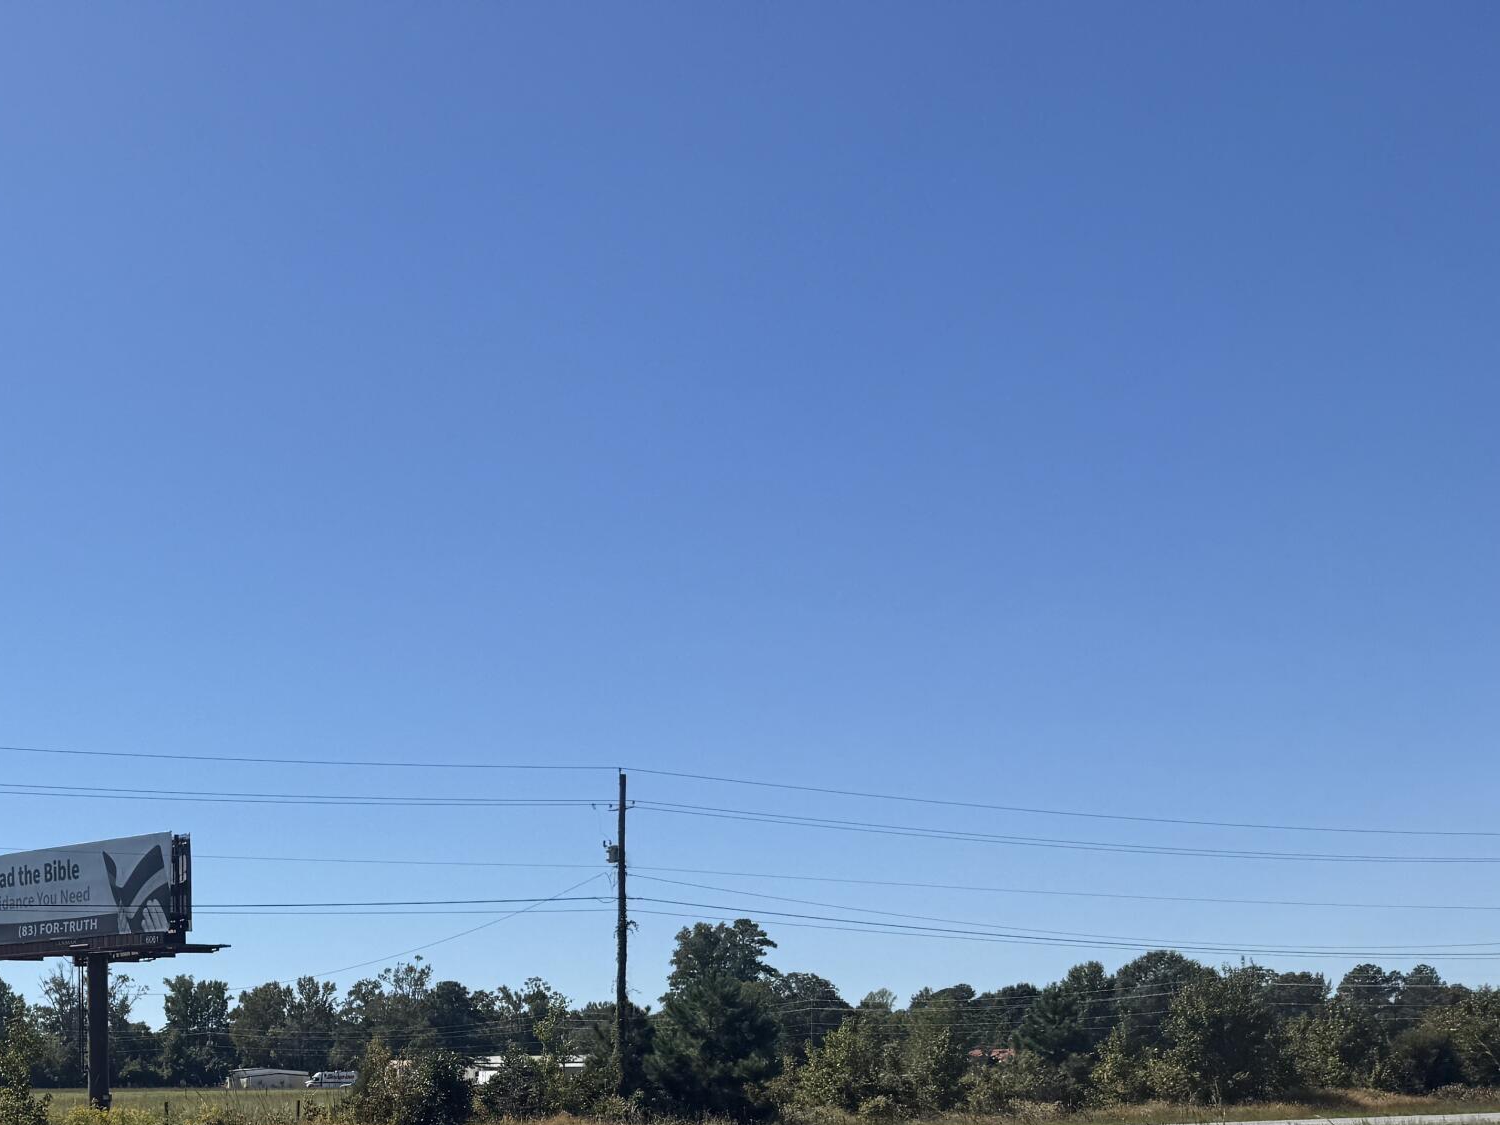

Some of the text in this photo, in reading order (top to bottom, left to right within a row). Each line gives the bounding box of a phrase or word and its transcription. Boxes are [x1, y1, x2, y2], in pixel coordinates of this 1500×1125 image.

[18, 863, 41, 886] the
[44, 859, 80, 883] Bible
[36, 890, 57, 906] You
[60, 886, 90, 904] Need
[18, 918, 98, 938] (83) FOR-TRUTH
